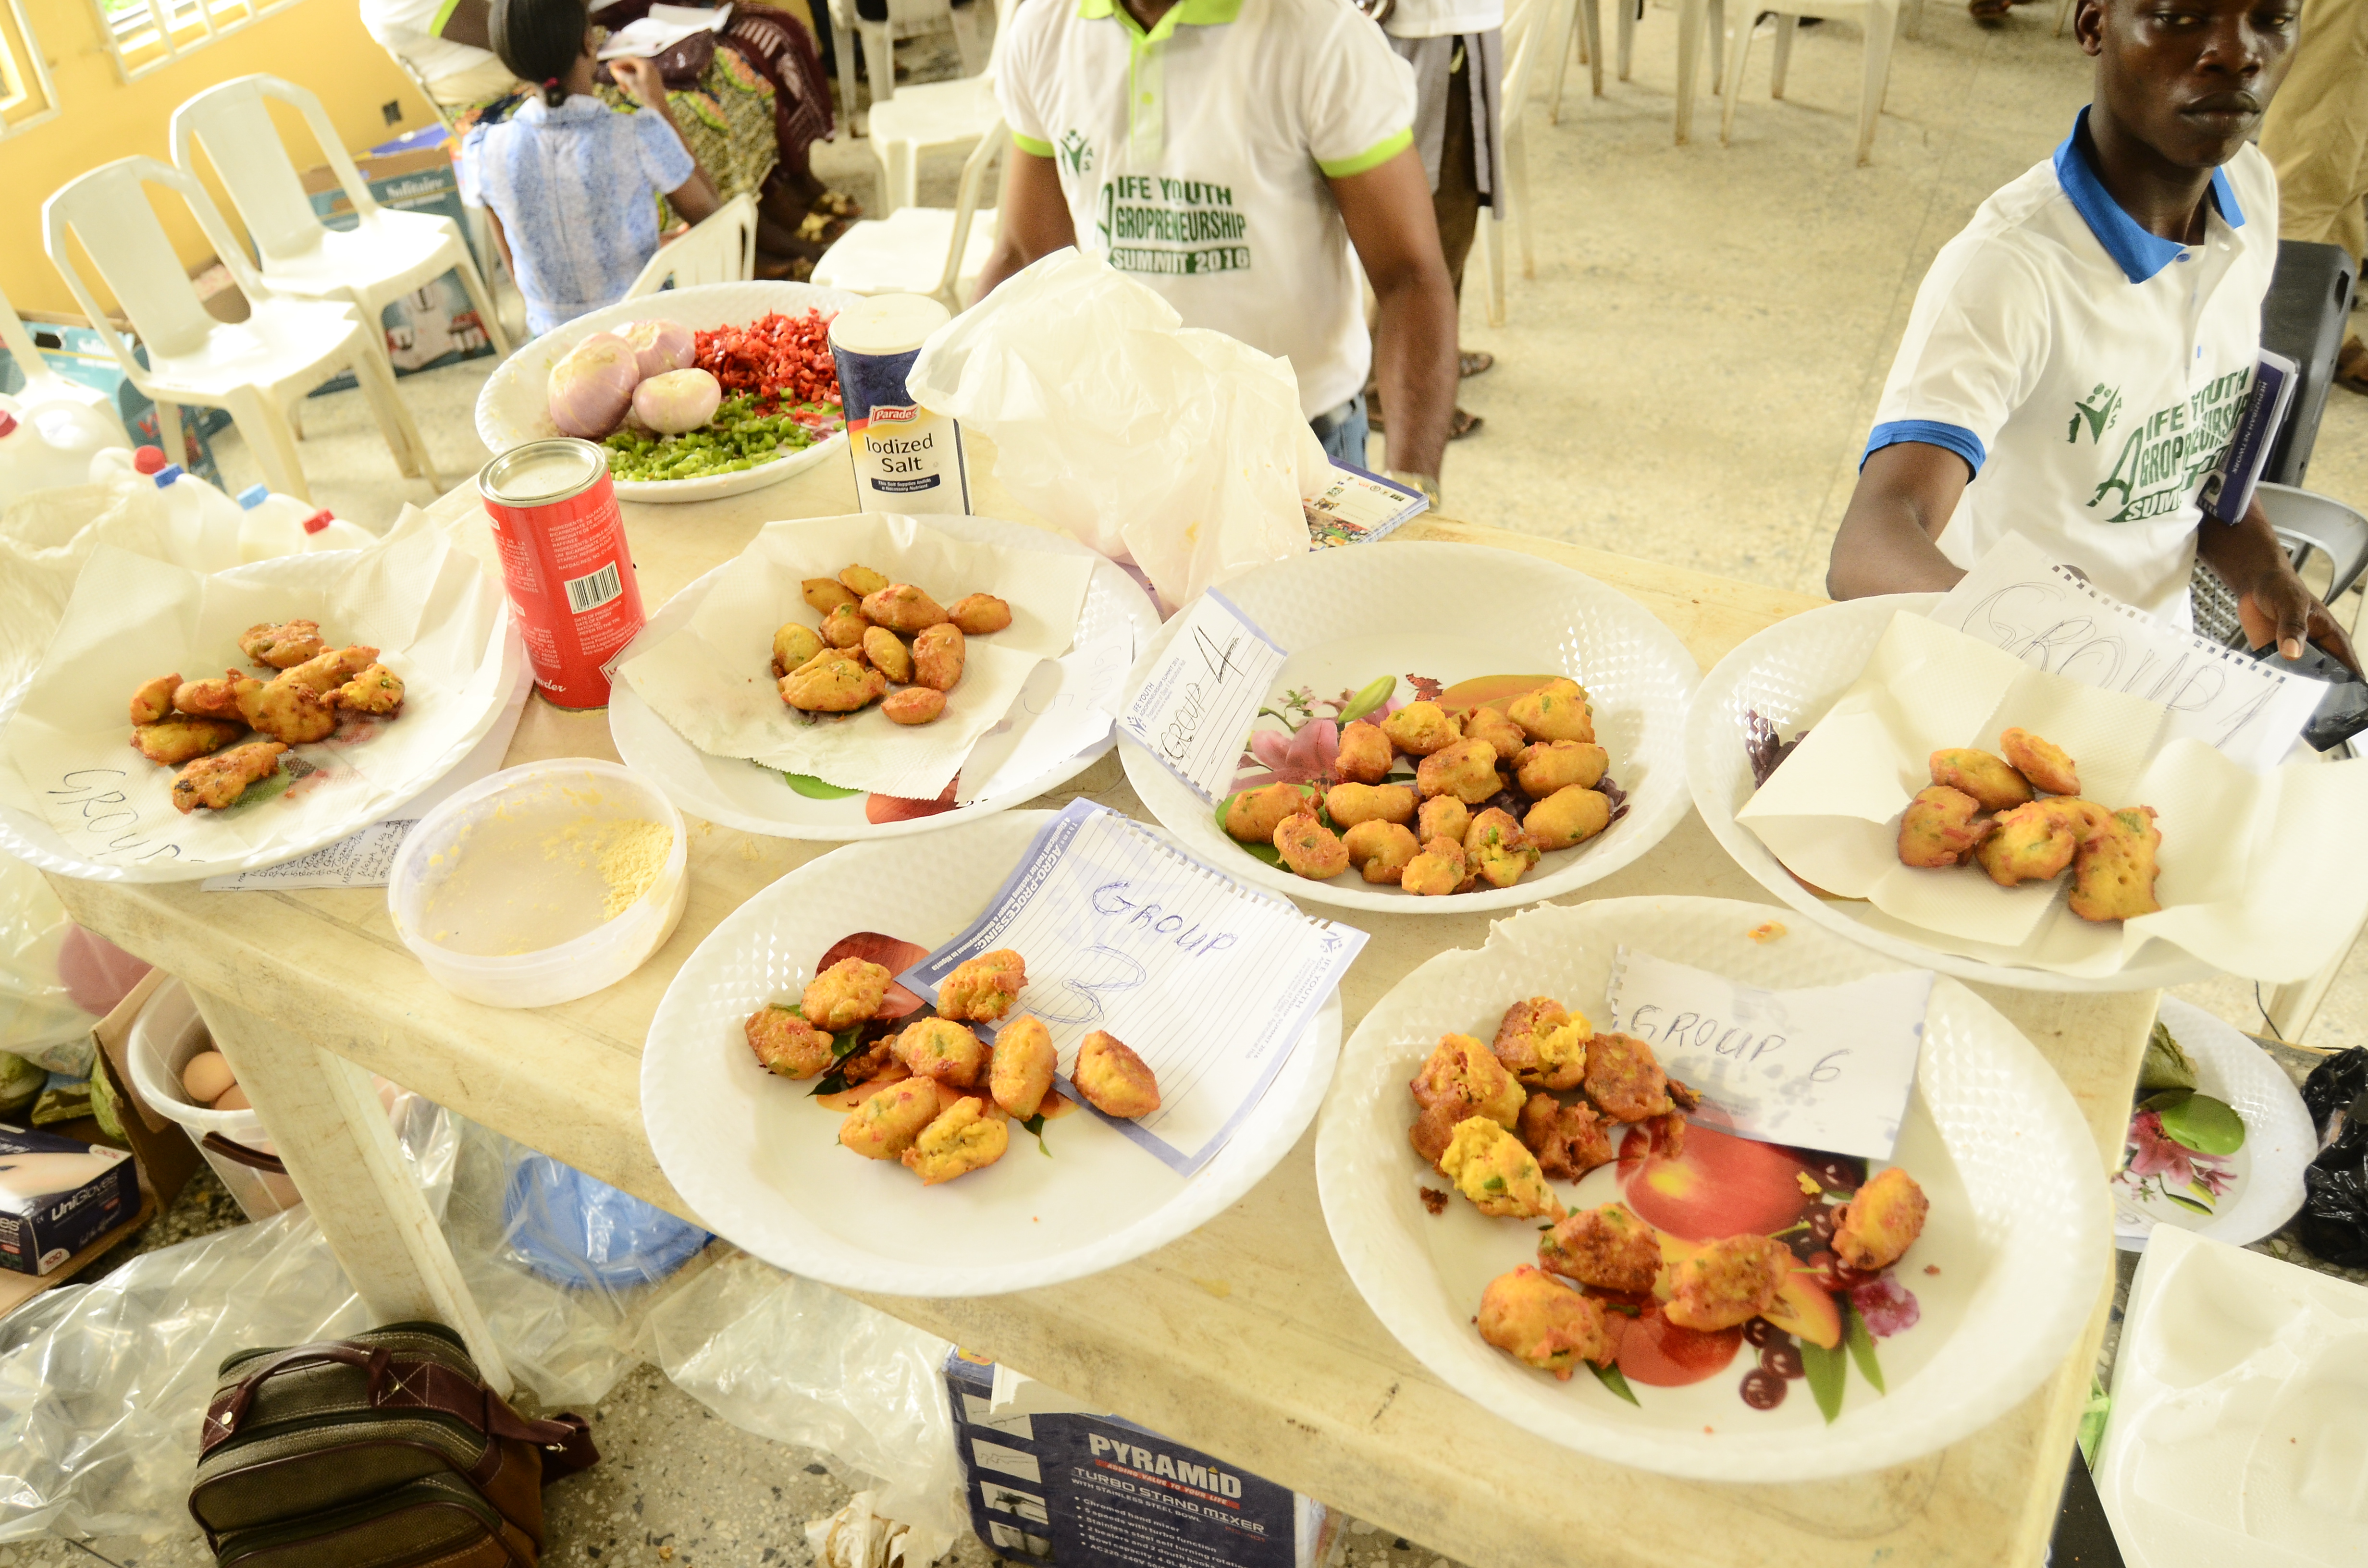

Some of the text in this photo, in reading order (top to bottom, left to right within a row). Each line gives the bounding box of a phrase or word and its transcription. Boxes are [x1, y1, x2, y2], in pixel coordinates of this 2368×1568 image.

[1117, 176, 1232, 206] IFE YOUTH
[1113, 247, 1250, 274] SUMMIT 2016
[876, 409, 911, 419] Parade
[2146, 402, 2185, 441] IFE
[2190, 366, 2251, 421] YOUTH
[866, 432, 933, 454] Iodized
[881, 456, 923, 473] Salt
[1161, 665, 1174, 682] SUMMIT
[1172, 657, 1180, 666] 2016
[1191, 625, 1245, 684] 4
[1132, 682, 1155, 712] IFE YOUTH
[1160, 682, 1206, 760] GROUP
[47, 769, 182, 860] GROUP
[1043, 820, 1067, 853] Significant
[1057, 821, 1077, 848] Theme:
[1028, 865, 1038, 875] for
[1034, 851, 1047, 867] Tool
[1011, 873, 1032, 899] Tackling
[996, 896, 1015, 918] Hunger
[1092, 881, 1238, 958] GROUP
[956, 920, 996, 955] Unemployment
[930, 954, 953, 971] Nigeria
[1021, 942, 1147, 1025] 3
[1295, 958, 1331, 1009] IFE YOUTH
[1264, 1017, 1283, 1043] SUMMIT
[1630, 1004, 1853, 1082] GROUP 6
[1253, 1043, 1265, 1059] 2016
[1071, 1478, 1202, 1522] WITH STAINLESS STEEL BOWL
[1073, 1467, 1264, 1533] TURBO STAND MIXER
[1141, 1474, 1167, 1486] VALUE
[1184, 1487, 1206, 1498] YOUR
[1209, 1495, 1227, 1505] LIFE
[1083, 1498, 1180, 1532] Chromed hand mixer
[1085, 1516, 1129, 1534] Stainless
[1131, 1531, 1154, 1542] steel
[1155, 1538, 1173, 1548] self
[1174, 1544, 1209, 1561] turning
[1087, 1534, 1112, 1546] Bowl
[1093, 1510, 1125, 1525] speeds
[1126, 1520, 1150, 1531] with
[1151, 1528, 1175, 1540] turbo
[1176, 1536, 1217, 1552] function
[1094, 1528, 1134, 1544] beaters
[1135, 1541, 1150, 1549] and
